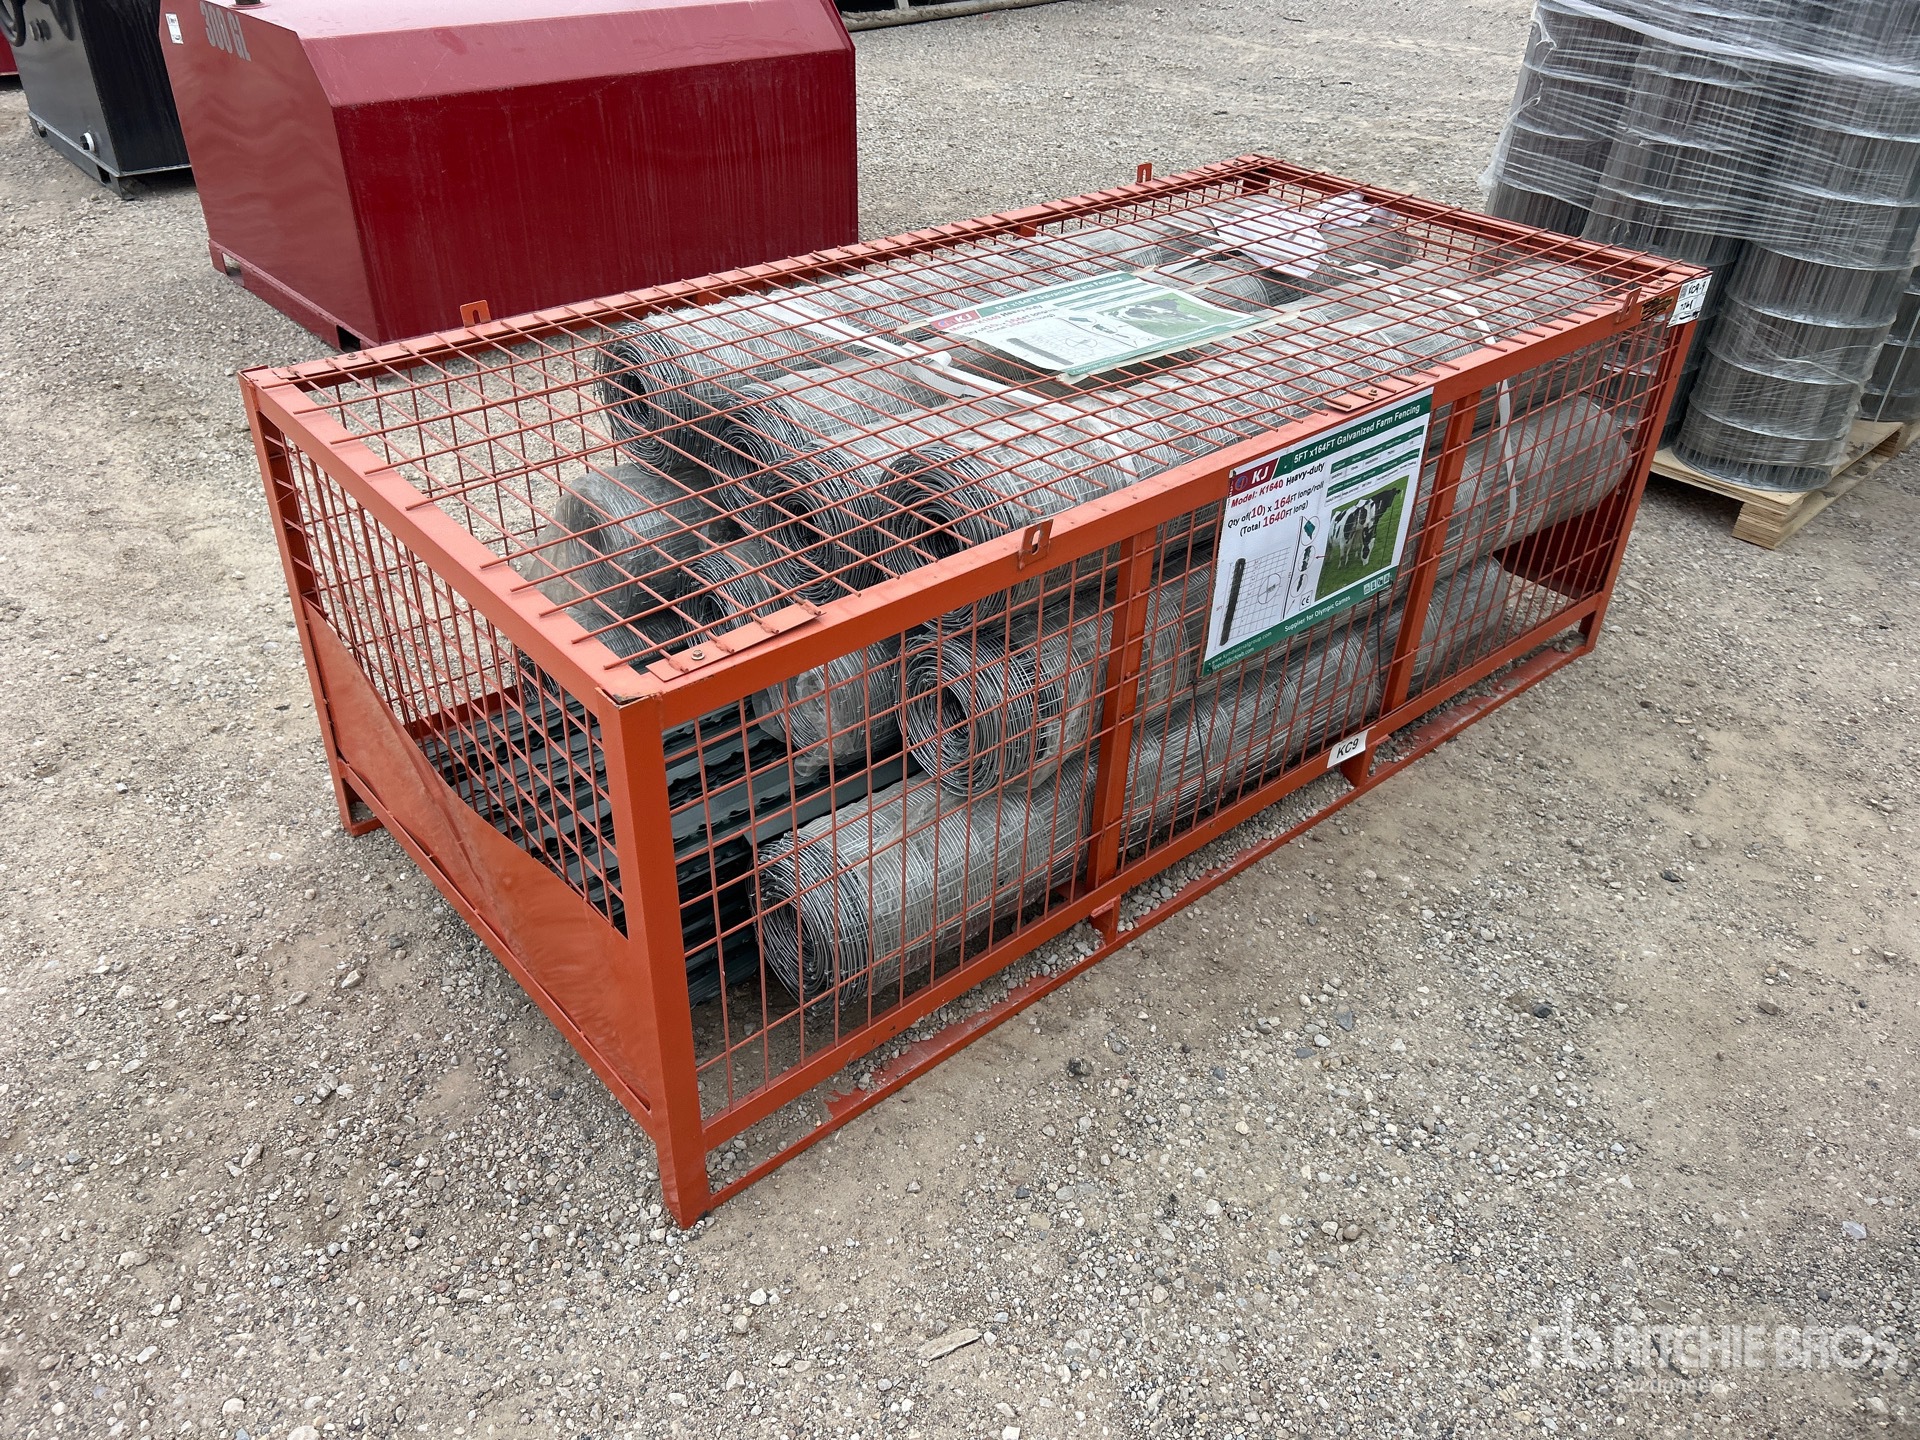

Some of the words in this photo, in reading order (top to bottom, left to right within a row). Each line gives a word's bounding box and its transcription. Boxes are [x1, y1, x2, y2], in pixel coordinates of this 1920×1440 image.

[200, 2, 233, 54] 300
[954, 312, 973, 323] KJ
[1293, 450, 1310, 463] 5FT
[1309, 438, 1336, 458] x164FT
[1337, 422, 1375, 445] Galvanized
[1376, 417, 1393, 429] Farm
[1394, 403, 1421, 422] Fencing
[1231, 490, 1258, 508] Model:
[1259, 479, 1284, 495] K1640
[1286, 463, 1325, 486] Heavy-duty
[1251, 465, 1270, 484] KJ
[1227, 518, 1241, 528] Qty
[1274, 494, 1297, 510] 164FT
[1297, 480, 1324, 498] long/roll
[1239, 520, 1261, 537] (Total
[1262, 508, 1292, 527] 1640FT
[1293, 500, 1309, 514] long)
[1284, 618, 1306, 632] Supplier
[1306, 613, 1315, 622] for
[1314, 602, 1335, 618] Olympic
[1335, 595, 1351, 607] Games
[1336, 737, 1359, 759] KC9
